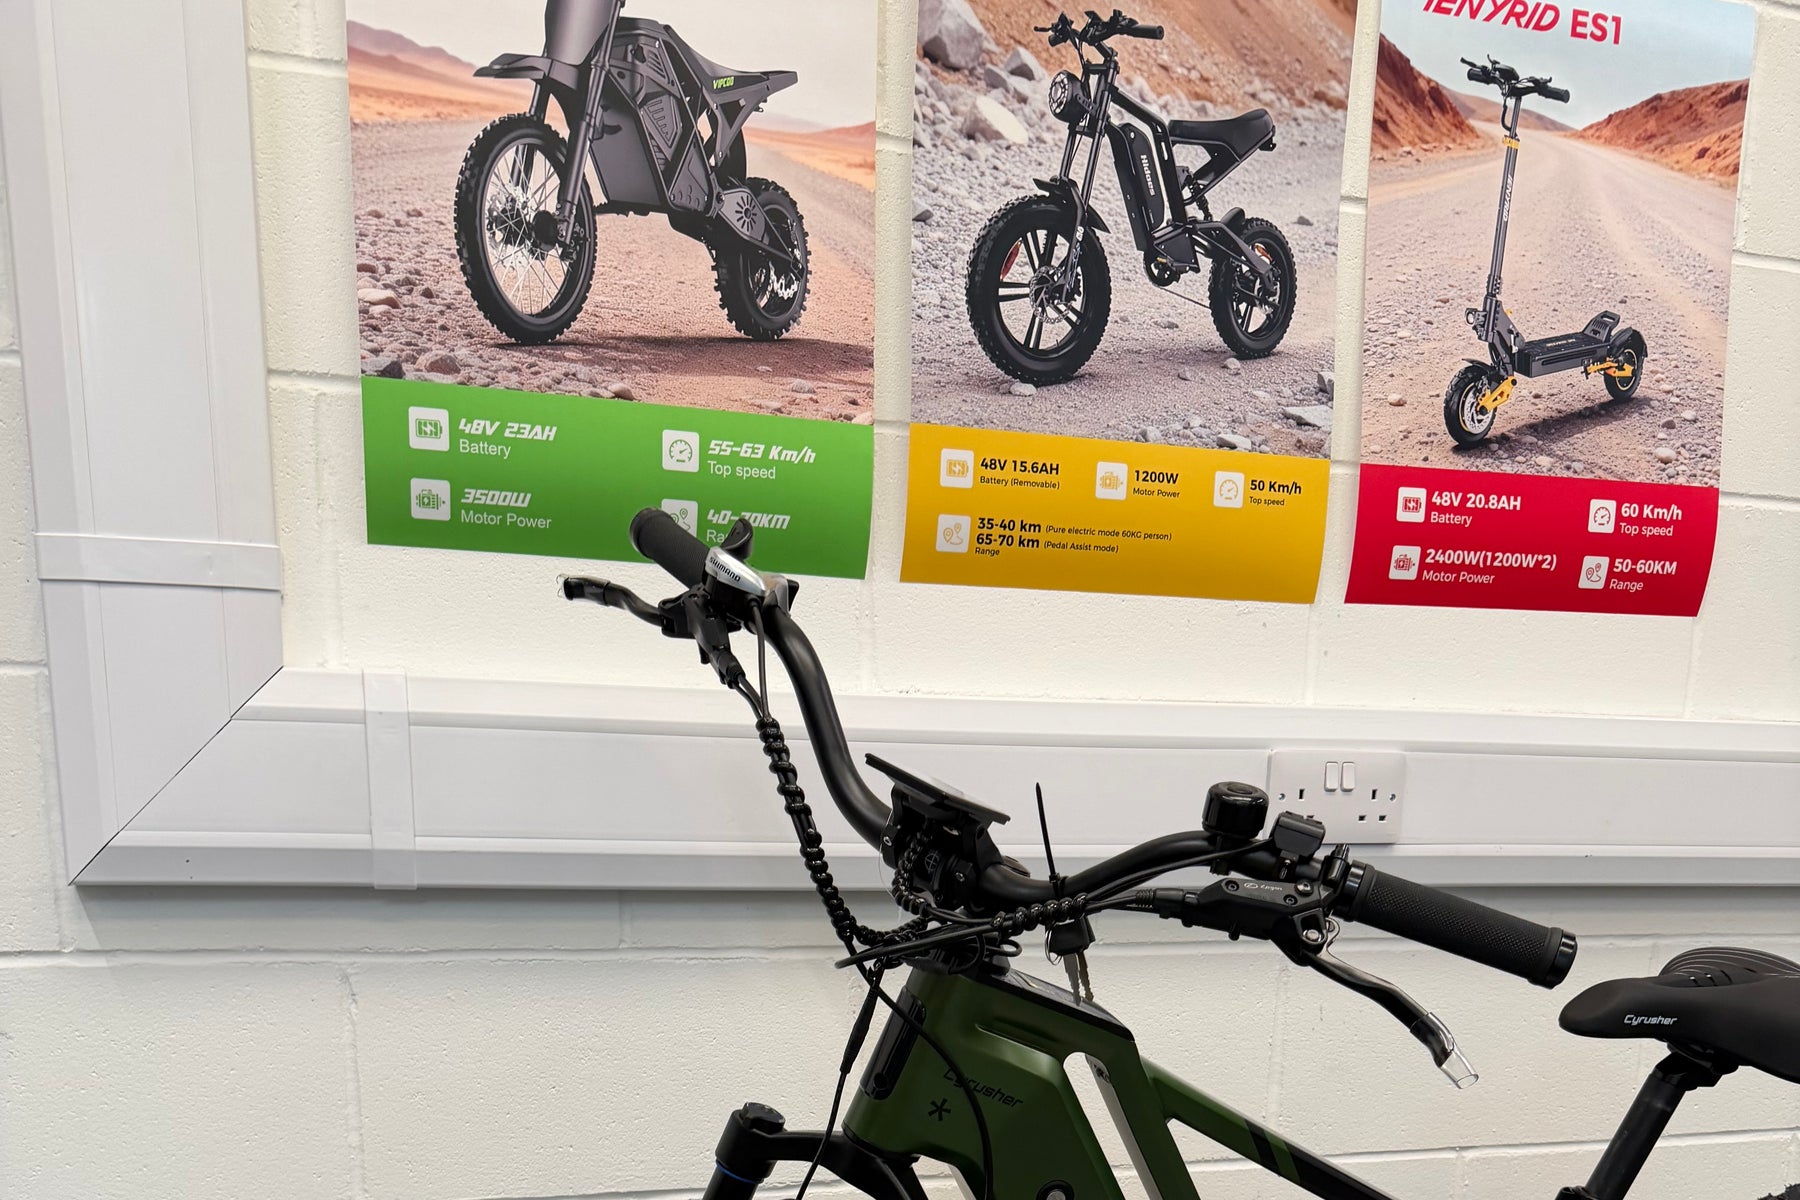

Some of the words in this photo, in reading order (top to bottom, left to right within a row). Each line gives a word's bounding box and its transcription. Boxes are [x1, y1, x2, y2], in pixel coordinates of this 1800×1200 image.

[1570, 8, 1622, 44] ES1
[459, 418, 498, 436] 48V
[504, 422, 557, 440] 23AH
[459, 439, 511, 460] Battery
[708, 440, 765, 458] 55-63
[768, 443, 816, 464] Km/h
[707, 461, 732, 479] Top
[736, 464, 776, 480] speed
[980, 457, 1008, 471] 48V
[1012, 460, 1059, 476] 15.6AH
[980, 475, 1009, 488] Battery
[1010, 477, 1060, 490] (Removable)
[1134, 470, 1179, 485] 1200W
[1133, 487, 1155, 497] Motor
[1157, 488, 1180, 498] Power
[1250, 479, 1265, 492] 50
[1268, 480, 1302, 495] Km/h
[462, 489, 531, 507] 3500W
[1249, 496, 1262, 506] Top
[1263, 497, 1285, 507] speed
[1432, 491, 1462, 506] 48V
[1466, 493, 1521, 510] 20.8AH
[461, 509, 501, 525] Motor
[507, 513, 552, 529] Power
[1431, 512, 1472, 527] Battery
[1622, 503, 1639, 517] 60
[1643, 504, 1682, 521] Km/h
[977, 517, 1016, 532] 35-40
[1019, 519, 1042, 534] km
[1045, 525, 1066, 535] (Pure
[1068, 526, 1096, 536] electric
[1097, 529, 1120, 537] mode
[1121, 530, 1142, 539] 60KG
[1143, 531, 1172, 542] person)
[1620, 523, 1638, 536] Top
[1642, 526, 1673, 537] speed
[976, 532, 1015, 547] 65-70
[1018, 534, 1040, 549] km
[1043, 540, 1067, 551] (Pedal
[1069, 541, 1091, 551] Assist
[1093, 543, 1119, 553] mode)
[974, 547, 1000, 558] Range
[710, 556, 742, 582] SHIMANO
[1614, 559, 1677, 574] 50-60KM
[1423, 570, 1456, 581] Motor
[1459, 572, 1494, 583] Power
[1610, 579, 1643, 592] Range
[1623, 1014, 1678, 1026] Cyrusher
